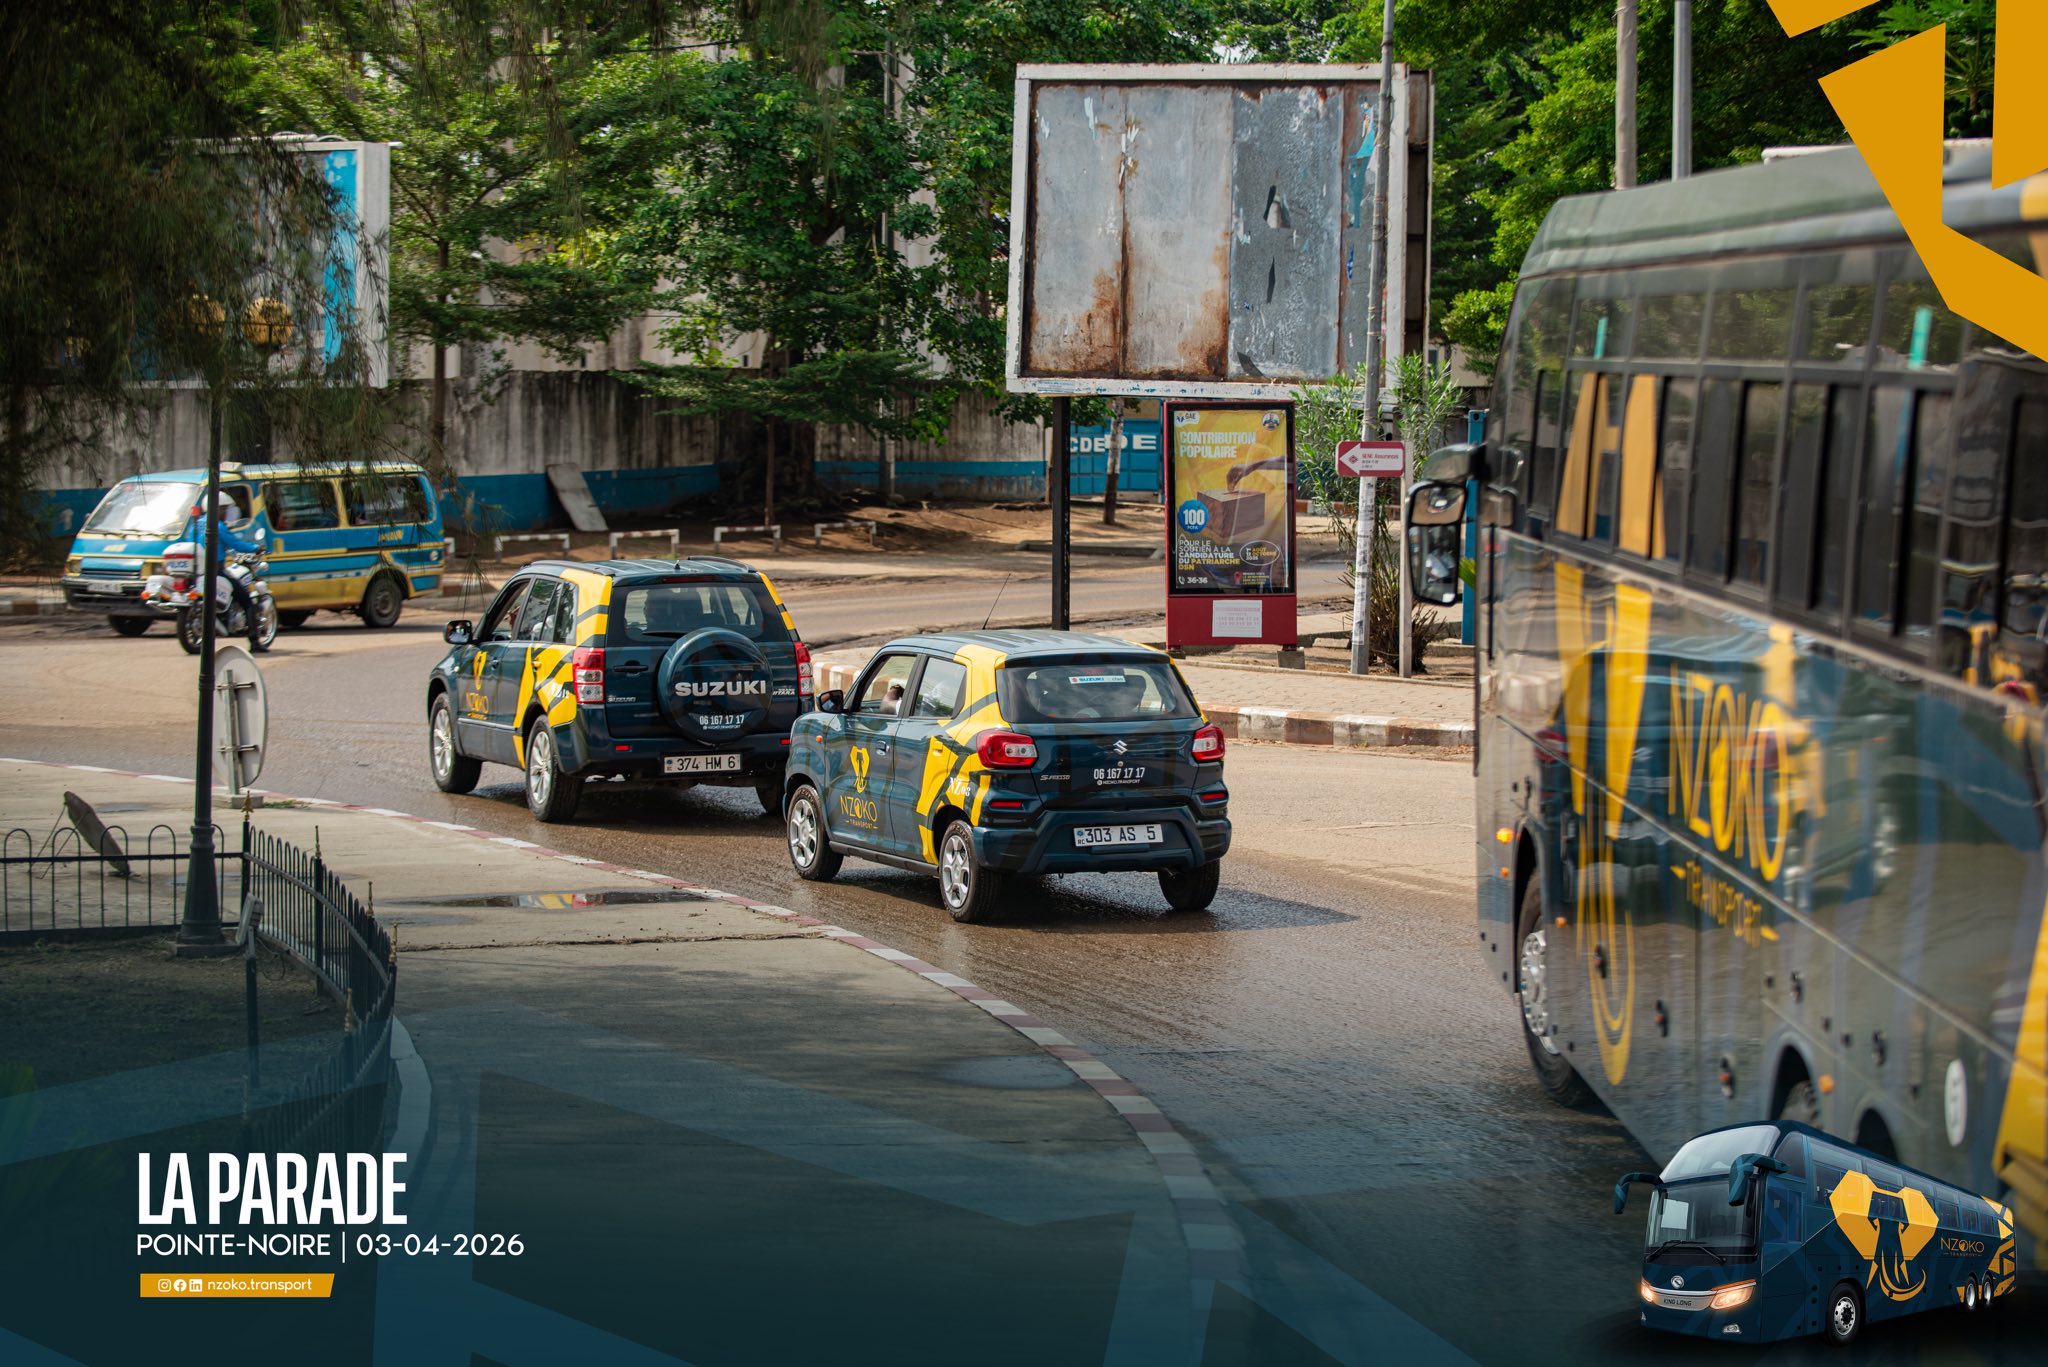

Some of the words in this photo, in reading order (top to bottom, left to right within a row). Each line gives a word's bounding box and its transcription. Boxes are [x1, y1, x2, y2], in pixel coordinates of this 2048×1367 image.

[1180, 431, 1256, 445] CONTRIBUTION
[1180, 445, 1237, 458] POPULAIRE
[1183, 509, 1205, 525] 100
[674, 680, 766, 697] SUZUKI
[700, 715, 709, 725] 06
[710, 715, 723, 725] 167
[725, 714, 734, 725] 17
[736, 714, 745, 724] 17
[677, 757, 699, 771] 374
[705, 756, 722, 770] HM
[728, 756, 736, 769] 6
[1093, 768, 1105, 780] 06
[1107, 768, 1121, 779] 167
[1123, 768, 1133, 779] 17
[1135, 767, 1145, 778] 17
[1668, 662, 1790, 882] NZOKO
[840, 796, 878, 822] NZOKO
[1085, 828, 1112, 843] 303
[1119, 827, 1136, 842] AS
[1146, 826, 1156, 840] 5
[1685, 860, 1762, 948] TRANSPORT
